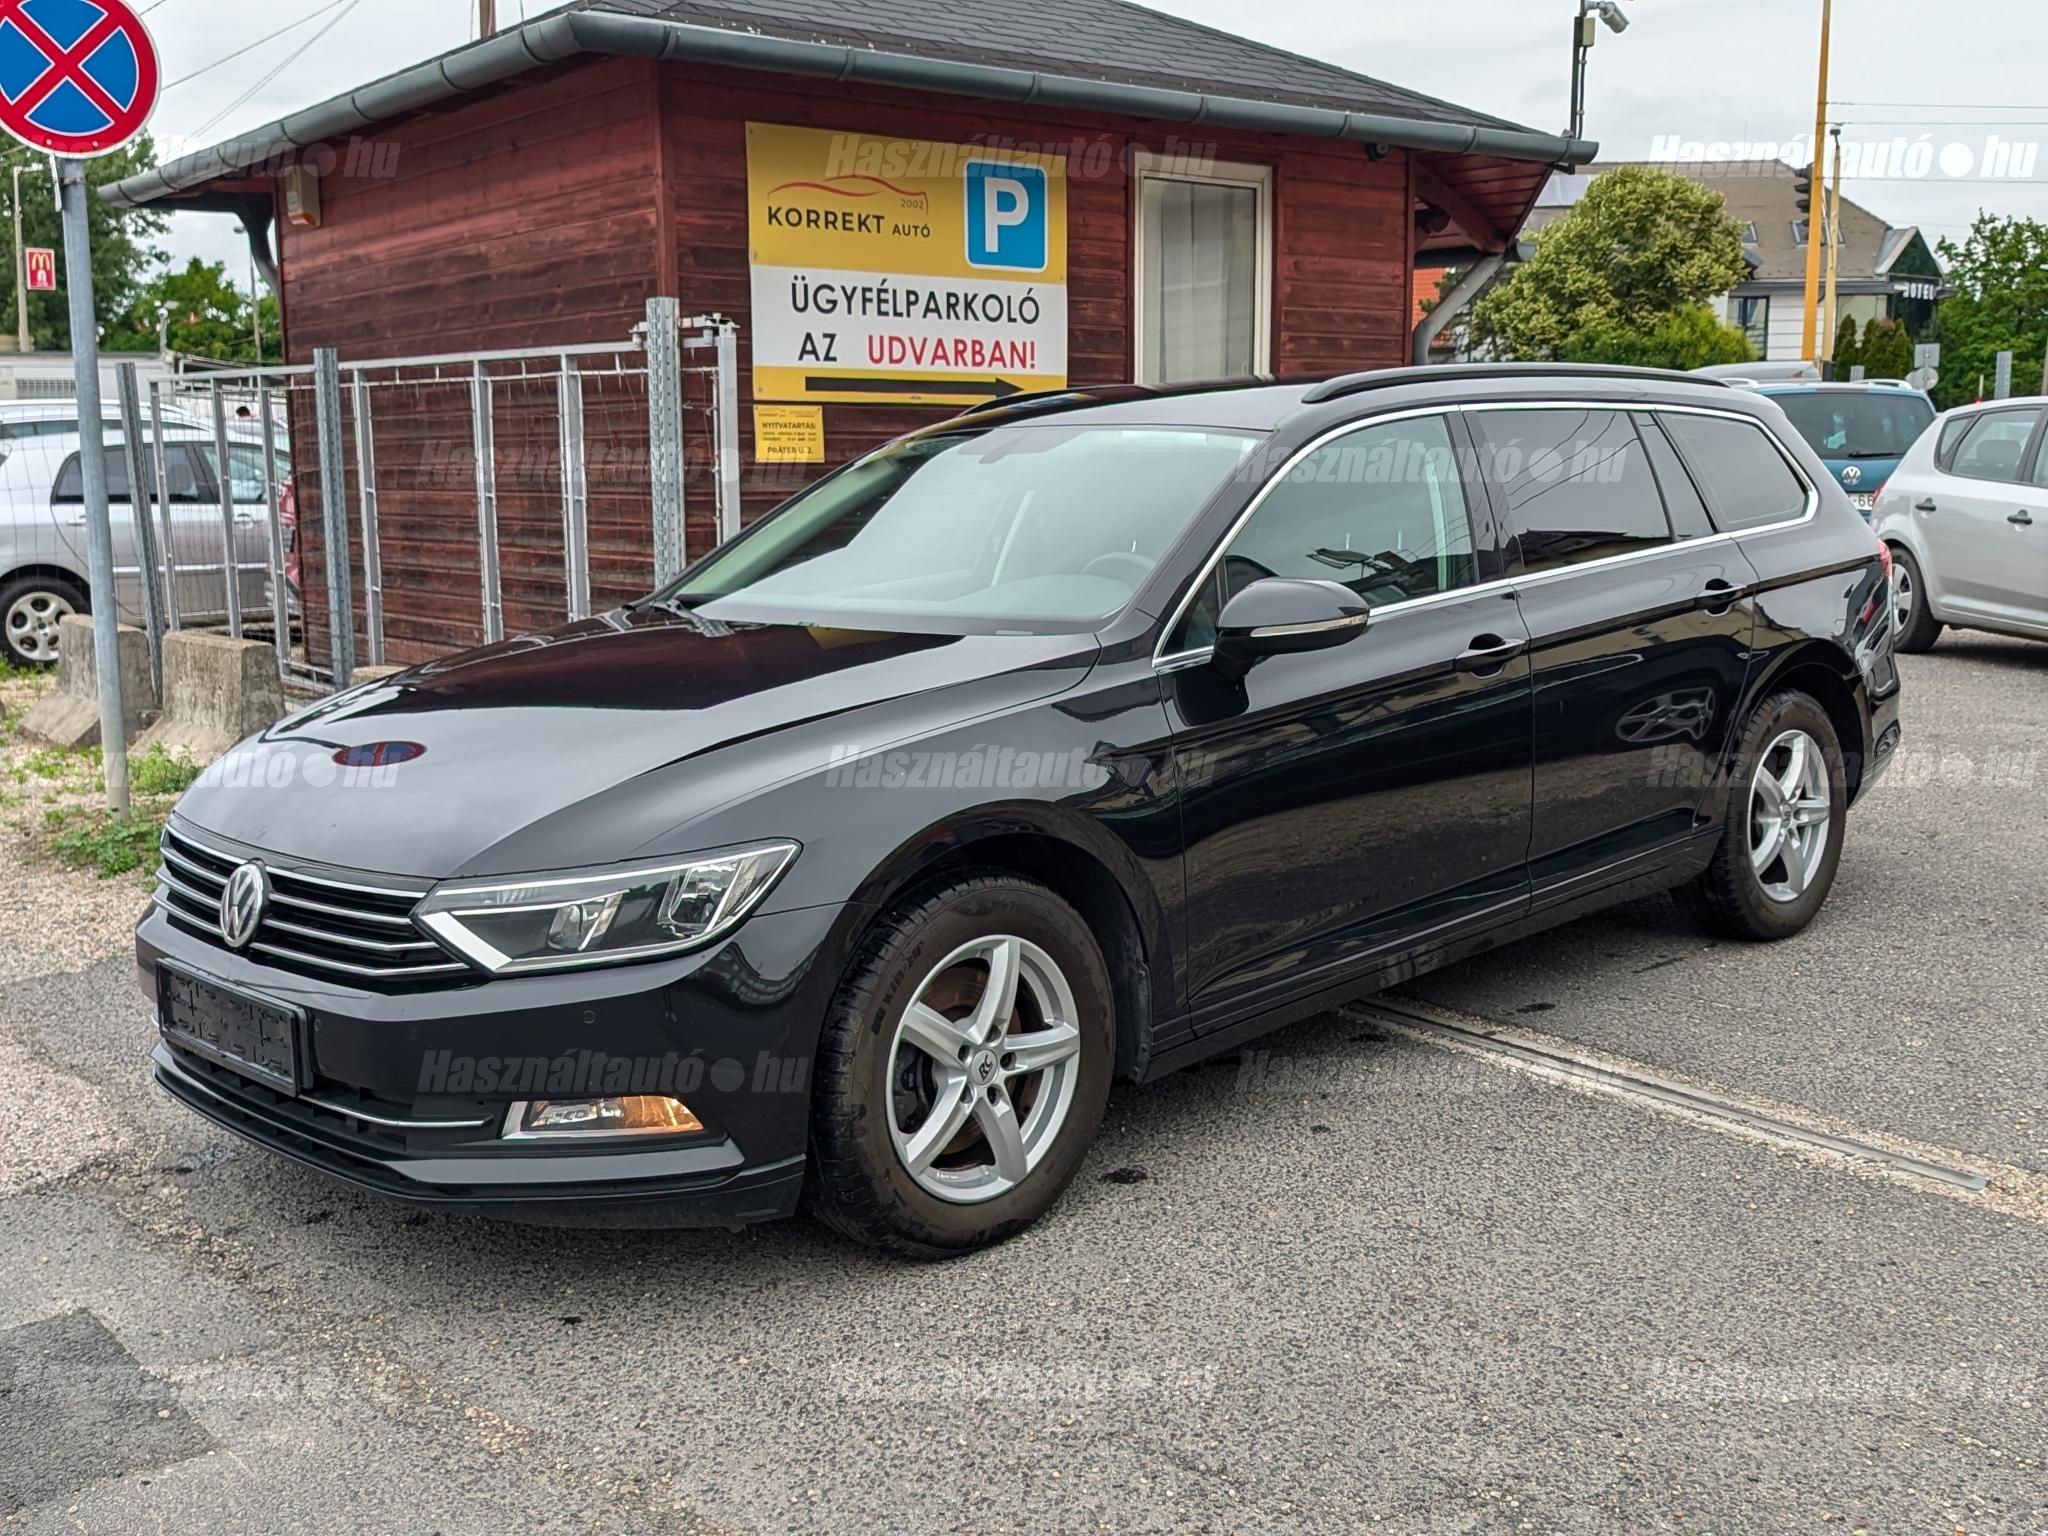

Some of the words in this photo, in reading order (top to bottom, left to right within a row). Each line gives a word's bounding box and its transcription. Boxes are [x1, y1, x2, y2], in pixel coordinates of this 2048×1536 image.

[767, 205, 886, 234] KORREKT
[891, 222, 931, 238] AUTÓ
[900, 199, 925, 210] 2002
[983, 175, 1030, 253] P
[790, 274, 1040, 325] ÜGYFÉLPARKOLÓ
[797, 332, 838, 362] AZ
[867, 334, 1036, 369] UDVARBAN!
